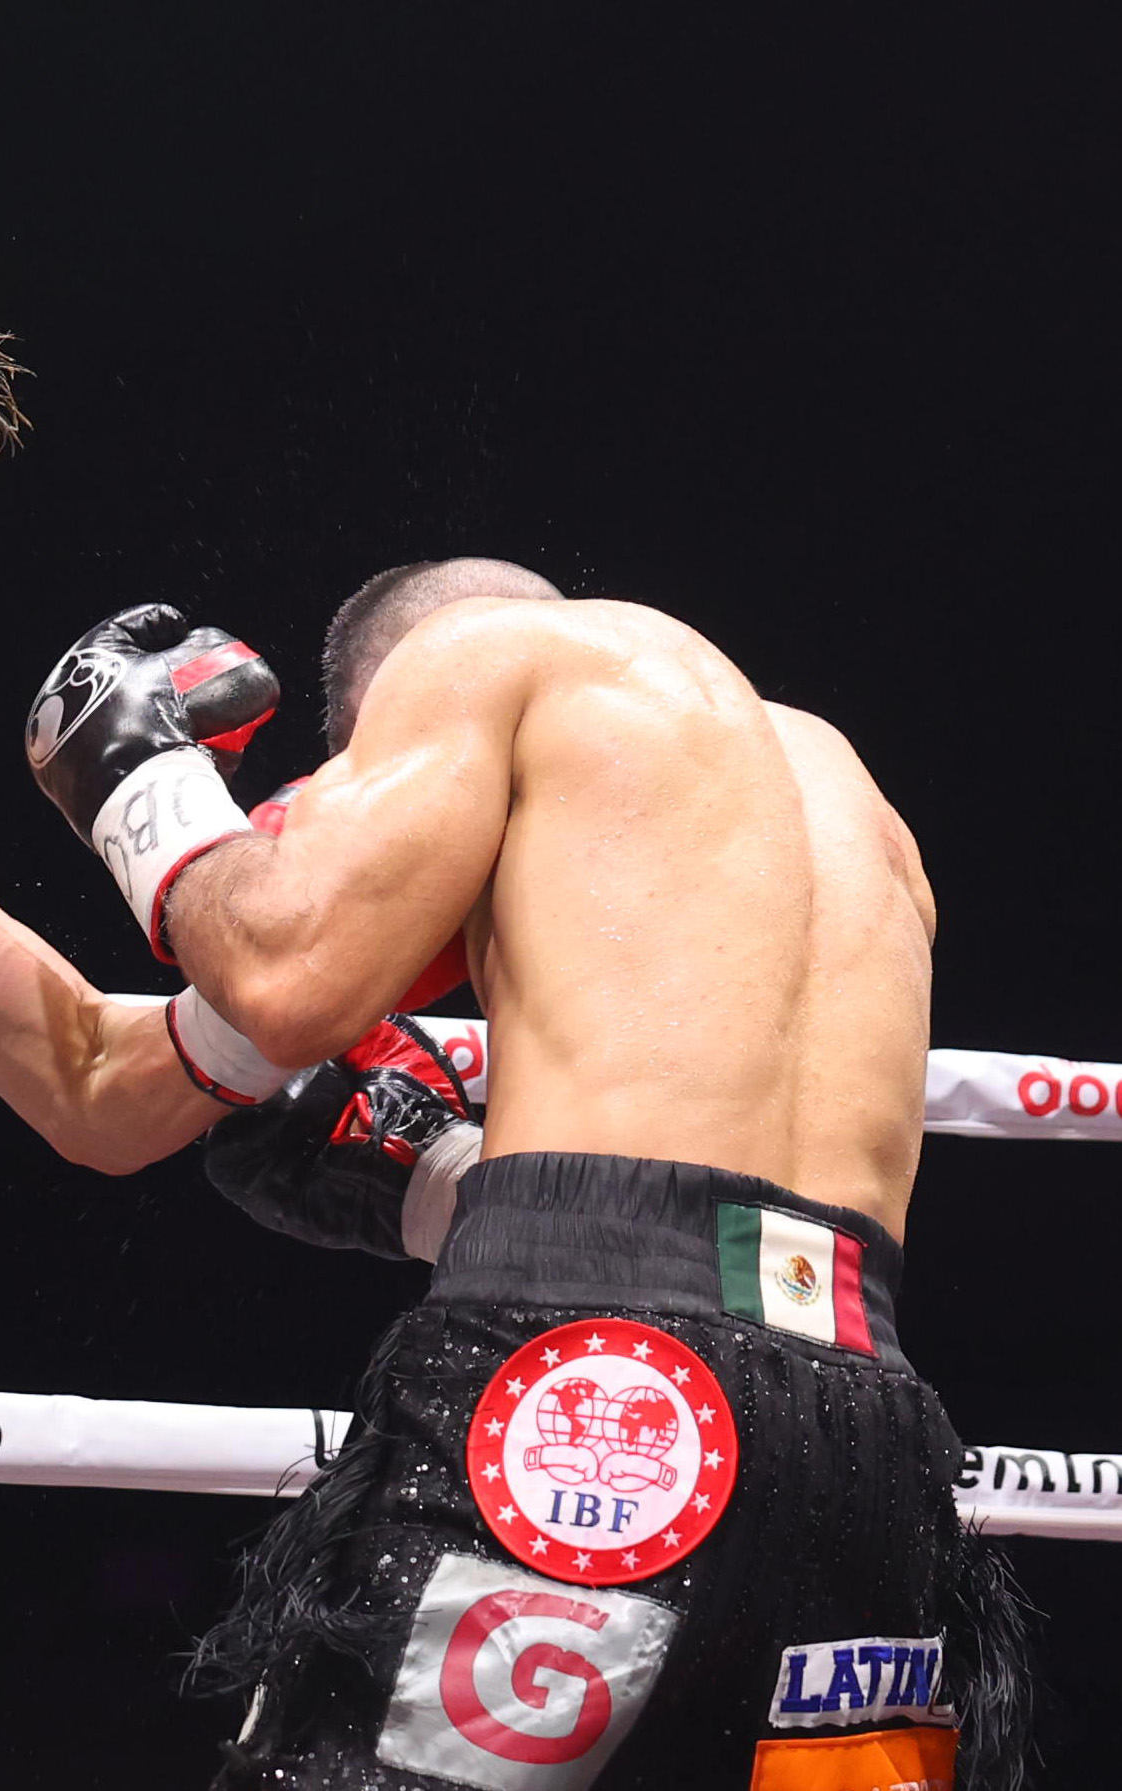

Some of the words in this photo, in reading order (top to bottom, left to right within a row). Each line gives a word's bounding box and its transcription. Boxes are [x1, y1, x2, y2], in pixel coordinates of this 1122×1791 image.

[954, 1446, 1122, 1495] emin
[545, 1489, 639, 1533] IBF
[439, 1589, 611, 1765] G
